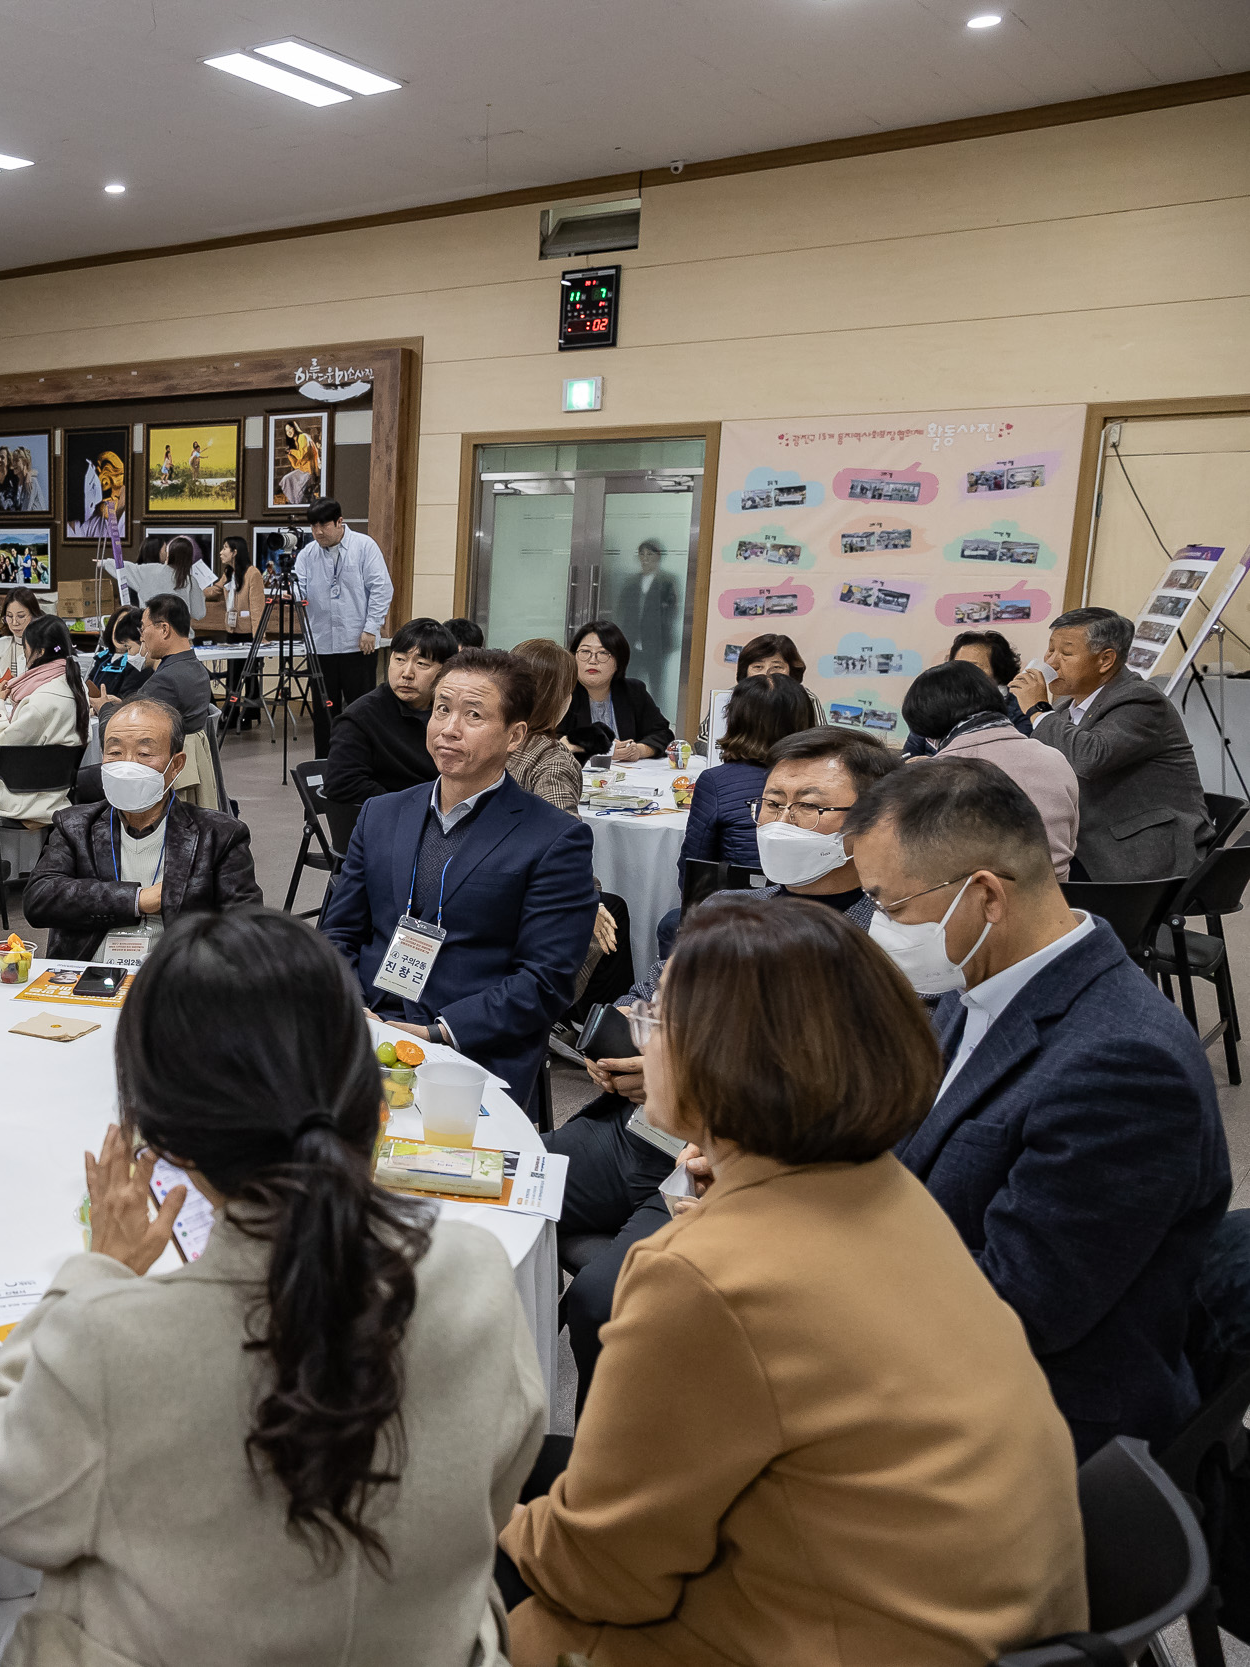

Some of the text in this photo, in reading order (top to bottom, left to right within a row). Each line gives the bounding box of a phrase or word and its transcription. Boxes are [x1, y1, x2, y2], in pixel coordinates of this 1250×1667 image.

[570, 288, 607, 301] 11 7
[793, 434, 816, 447] 광진구
[837, 429, 924, 446] 동지역사회보장협의체
[927, 423, 996, 451] 활동사진
[117, 958, 142, 966] 구의2동
[401, 954, 427, 970] 구의2동
[385, 960, 397, 974] 진
[398, 965, 410, 979] 창
[412, 971, 424, 985] 근
